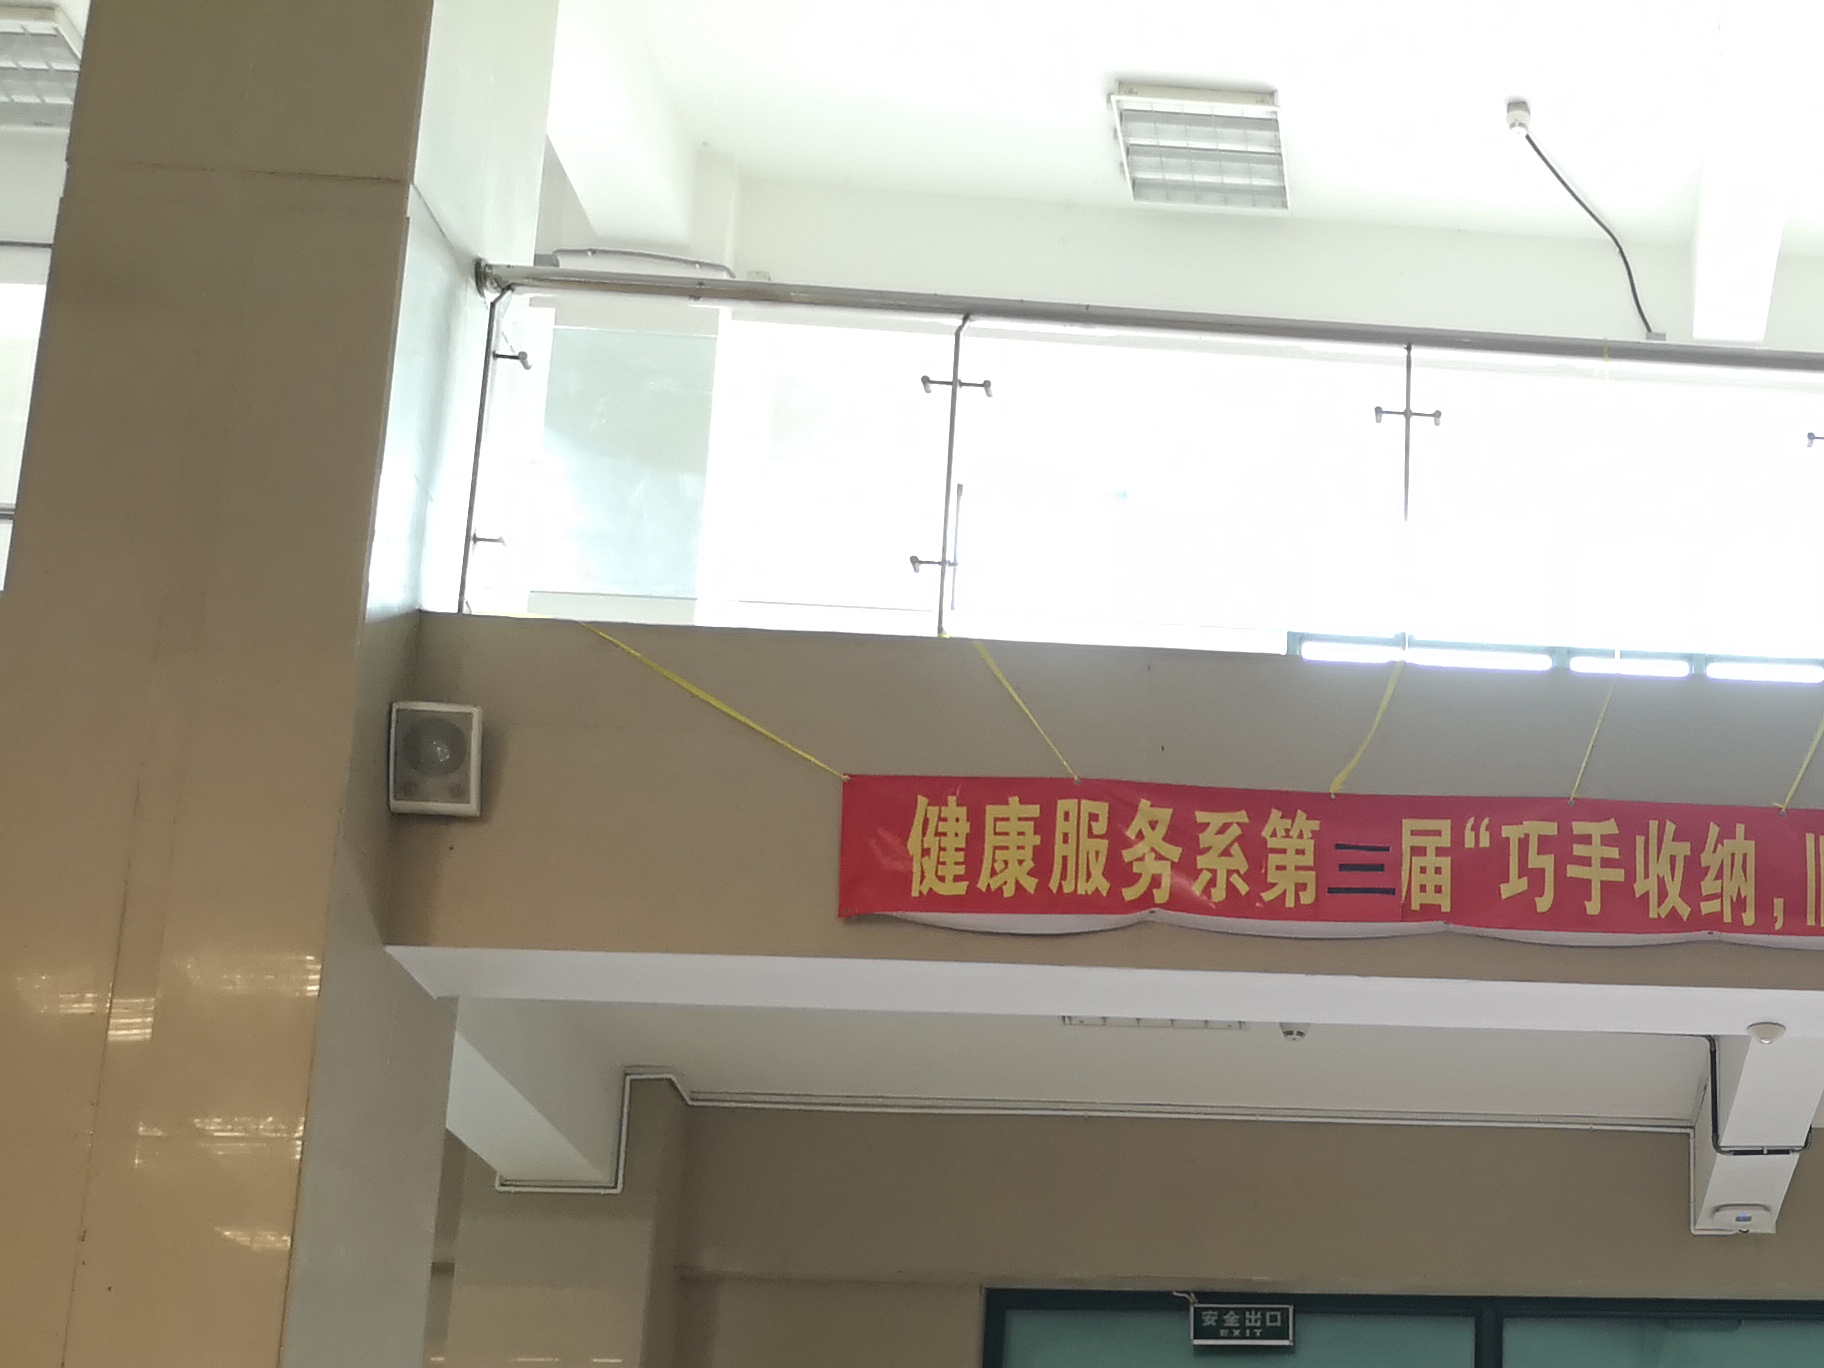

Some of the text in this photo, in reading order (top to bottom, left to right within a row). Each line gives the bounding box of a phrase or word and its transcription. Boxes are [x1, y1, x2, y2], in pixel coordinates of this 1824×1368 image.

[1202, 1310, 1281, 1327] 安全出口
[1219, 1329, 1263, 1337] EXIT
